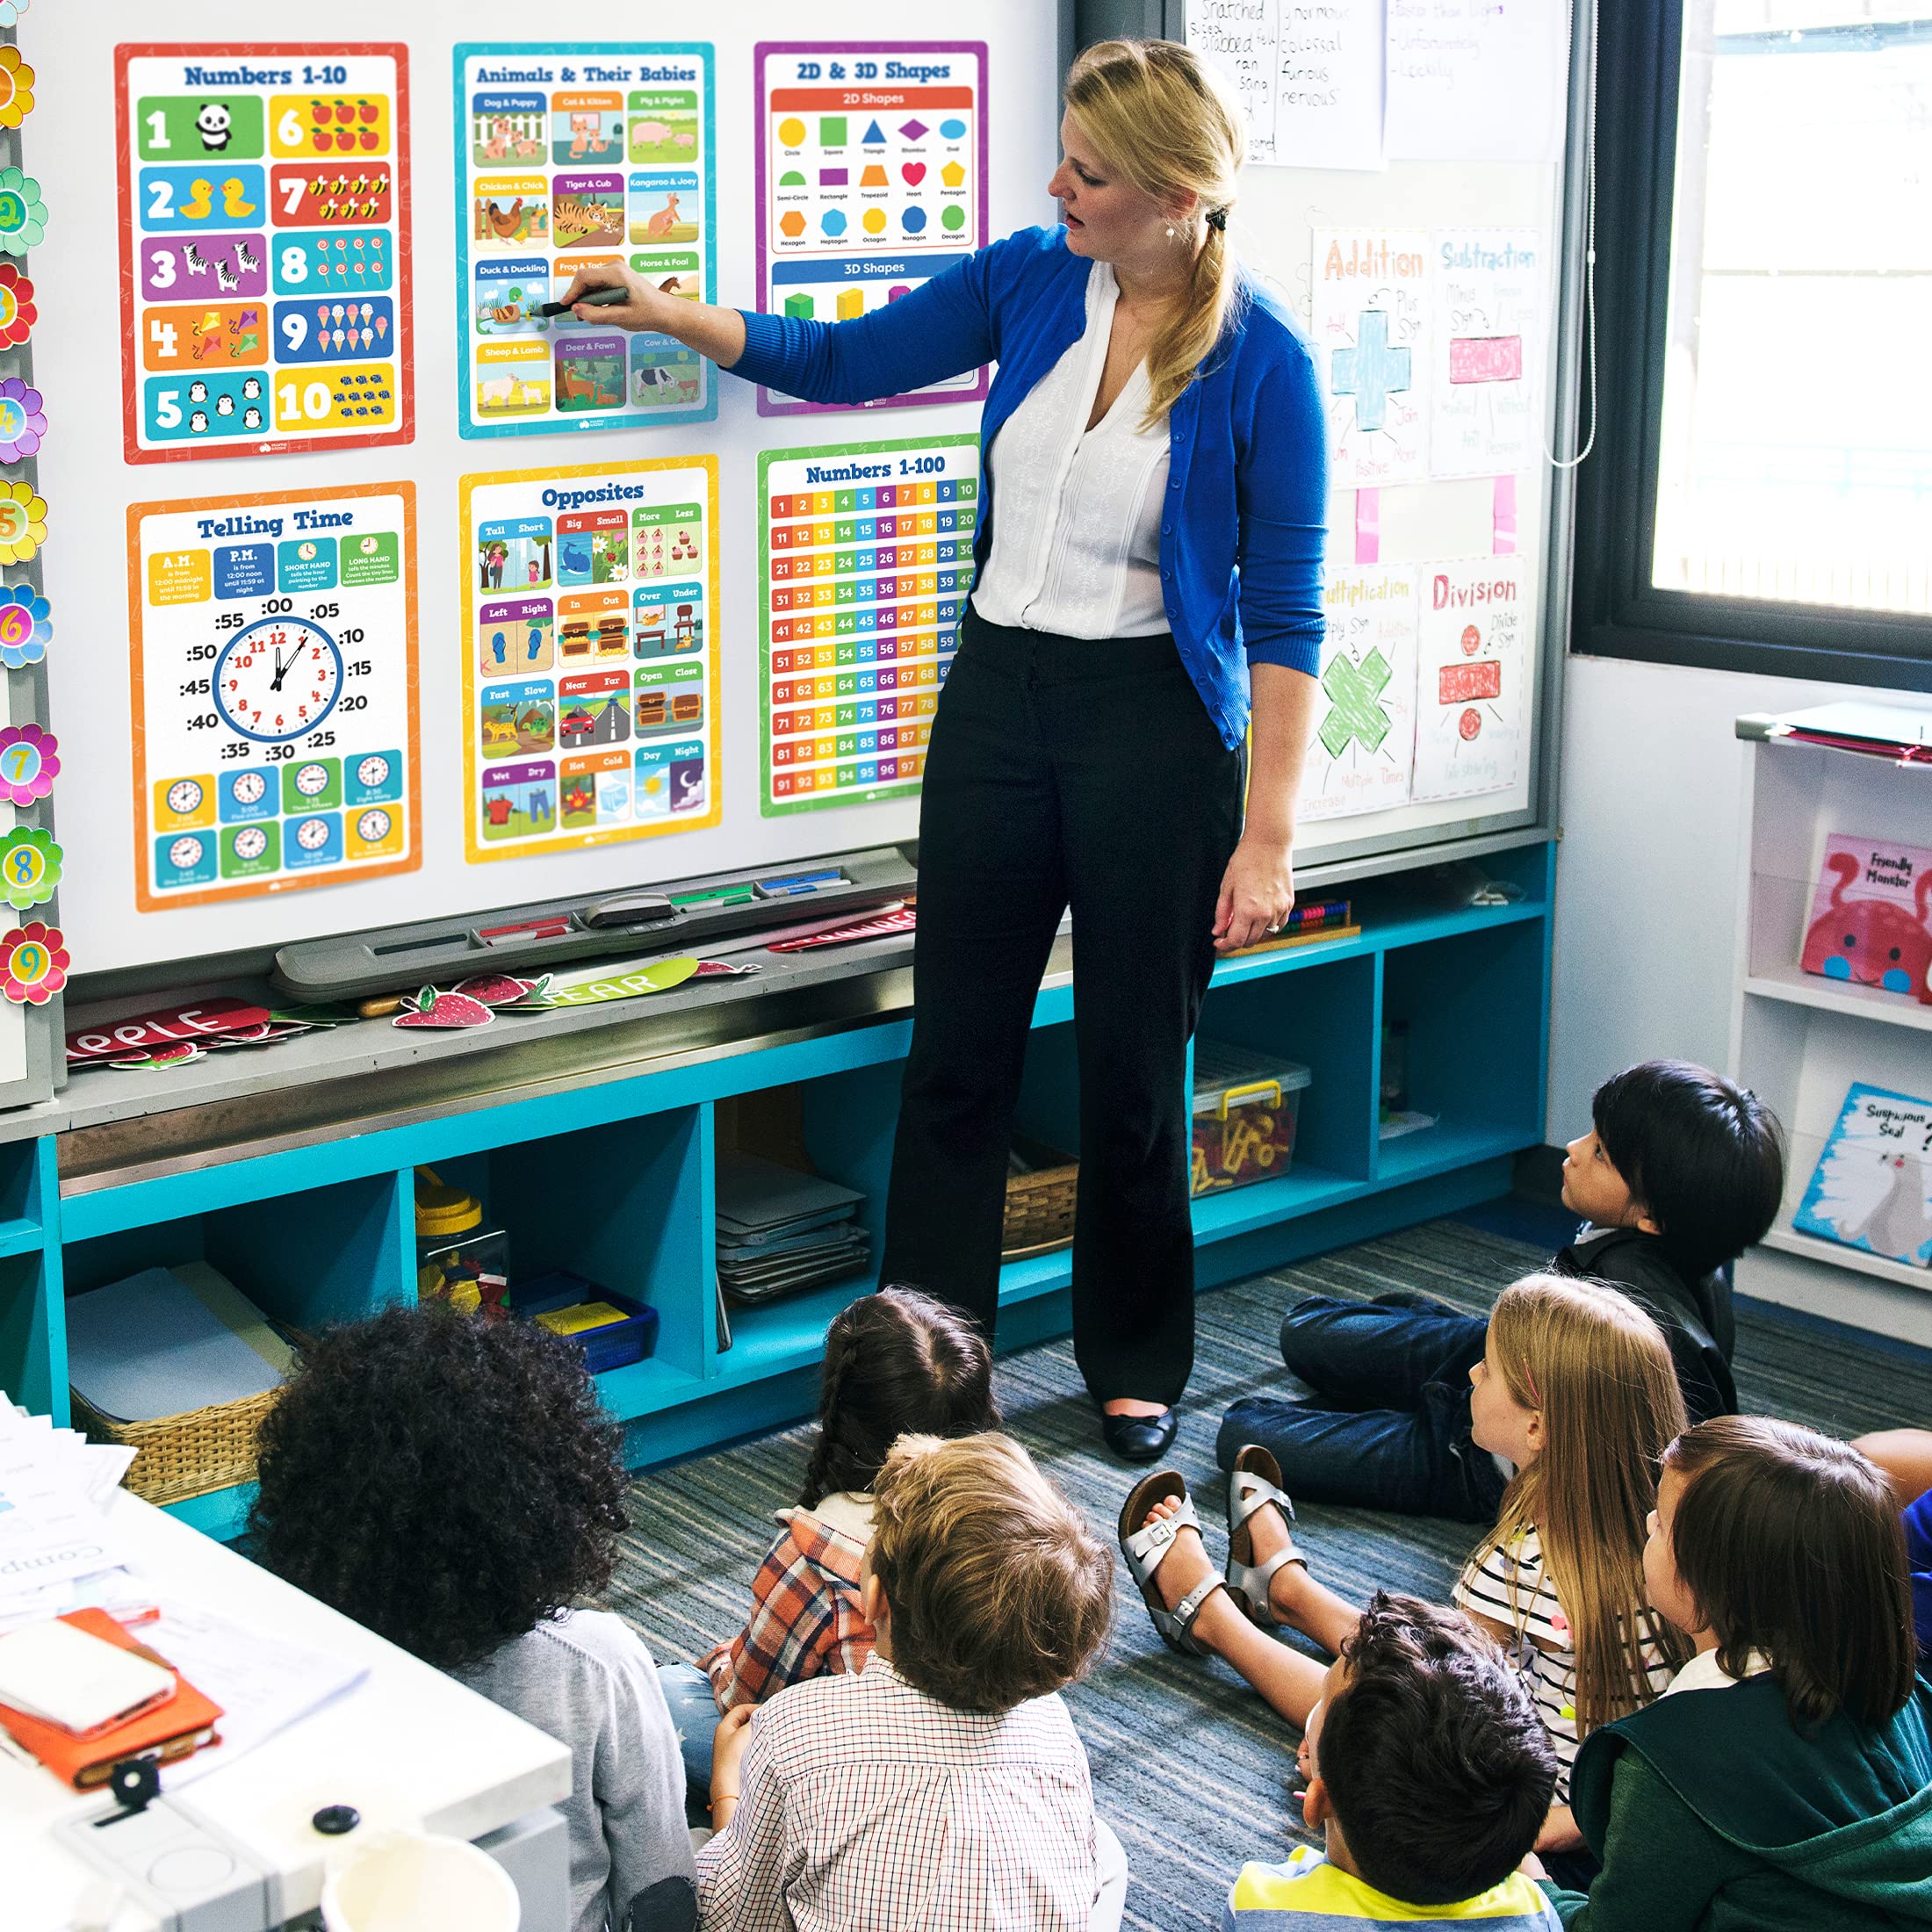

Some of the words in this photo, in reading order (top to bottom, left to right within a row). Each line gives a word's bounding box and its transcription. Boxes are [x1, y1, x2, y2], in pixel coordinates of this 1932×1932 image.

[797, 62, 820, 79] 2D
[829, 62, 846, 79] &
[854, 62, 877, 79] 3D
[885, 61, 950, 83] Shapes
[1236, 60, 1258, 69] ran
[184, 66, 292, 86] Numbers
[303, 66, 347, 84] 1-10
[477, 68, 553, 83] Animals
[560, 68, 575, 82] &
[583, 67, 631, 82] Their
[639, 66, 696, 82] Babies
[485, 98, 501, 108] Dog
[511, 98, 537, 108] Puppy
[640, 97, 652, 105] Pig
[662, 97, 685, 105] Piglet
[843, 94, 860, 104] 2D
[862, 93, 905, 105] Shapes
[146, 110, 170, 148] 1
[278, 108, 304, 146] 6
[566, 180, 586, 190] Tiger
[631, 178, 668, 188] Kangaroo
[677, 177, 696, 186] Joey
[148, 181, 175, 218] 2
[279, 177, 308, 214] 7
[0, 196, 20, 226] 2
[640, 259, 662, 268] Horse
[672, 257, 688, 266] Foal
[1324, 239, 1424, 280] Addition
[1441, 242, 1536, 270] Subtraction
[149, 251, 177, 288] 3
[281, 247, 307, 283] 8
[511, 264, 546, 274] Duckling
[559, 263, 578, 271] Frog
[844, 264, 861, 275] 3D
[862, 263, 905, 276] Shapes
[150, 319, 178, 357] 4
[282, 314, 308, 351] 9
[485, 349, 510, 357] Sheep
[520, 346, 544, 355] Lamb
[278, 382, 332, 420] 10
[155, 391, 183, 429] 5
[806, 463, 891, 484] Numbers
[899, 456, 945, 475] 1-100
[542, 483, 644, 510] Opposites
[779, 501, 784, 512] 1
[799, 500, 807, 510] 2
[820, 498, 827, 508] 3
[840, 496, 848, 506] 4
[862, 494, 869, 504] 5
[882, 493, 890, 502] 6
[903, 490, 910, 501] 7
[923, 488, 930, 498] 8
[942, 487, 950, 496] 9
[961, 484, 972, 494] 10
[0, 506, 16, 537] 5
[566, 519, 582, 530] Big
[596, 515, 624, 525] Small
[639, 512, 660, 521] More
[675, 508, 694, 518] Less
[198, 514, 284, 538] Telling
[293, 509, 353, 530] Time
[486, 526, 506, 536] Tall
[518, 523, 544, 532] Short
[162, 555, 194, 568] A.M.
[230, 549, 257, 562] P.M.
[285, 563, 308, 572] SHORT
[639, 592, 660, 601] Over
[673, 588, 698, 597] Under
[1324, 576, 1409, 607] ultiplication
[1432, 574, 1516, 610] Division
[261, 598, 292, 615] :00
[489, 608, 508, 617] Left
[522, 603, 547, 615] Right
[570, 600, 580, 609] In
[602, 595, 619, 605] Out
[310, 602, 340, 620] :05
[2, 606, 22, 642] 6
[215, 613, 244, 630] :55
[339, 628, 364, 645] :10
[186, 645, 217, 661] :50
[348, 660, 371, 678] :15
[640, 672, 663, 681] Open
[674, 667, 697, 676] Close
[179, 679, 210, 696] :45
[566, 681, 588, 690] Near
[604, 676, 620, 686] Far
[489, 689, 510, 699] Fast
[524, 685, 547, 696] Slow
[339, 695, 368, 712] :20
[187, 713, 219, 731] :40
[307, 731, 335, 748] :25
[221, 742, 249, 759] :35
[265, 745, 295, 761] :30
[643, 750, 660, 761] Day
[674, 746, 699, 757] Night
[10, 750, 29, 780] 7
[569, 761, 586, 771] Hot
[603, 755, 623, 766] Cold
[493, 771, 509, 781] Wet
[528, 767, 545, 777] Dry
[14, 849, 34, 883] 8
[1871, 852, 1913, 876] Friendly
[1866, 869, 1911, 888] Monster
[20, 945, 40, 979] 9
[549, 975, 658, 1002] EAR
